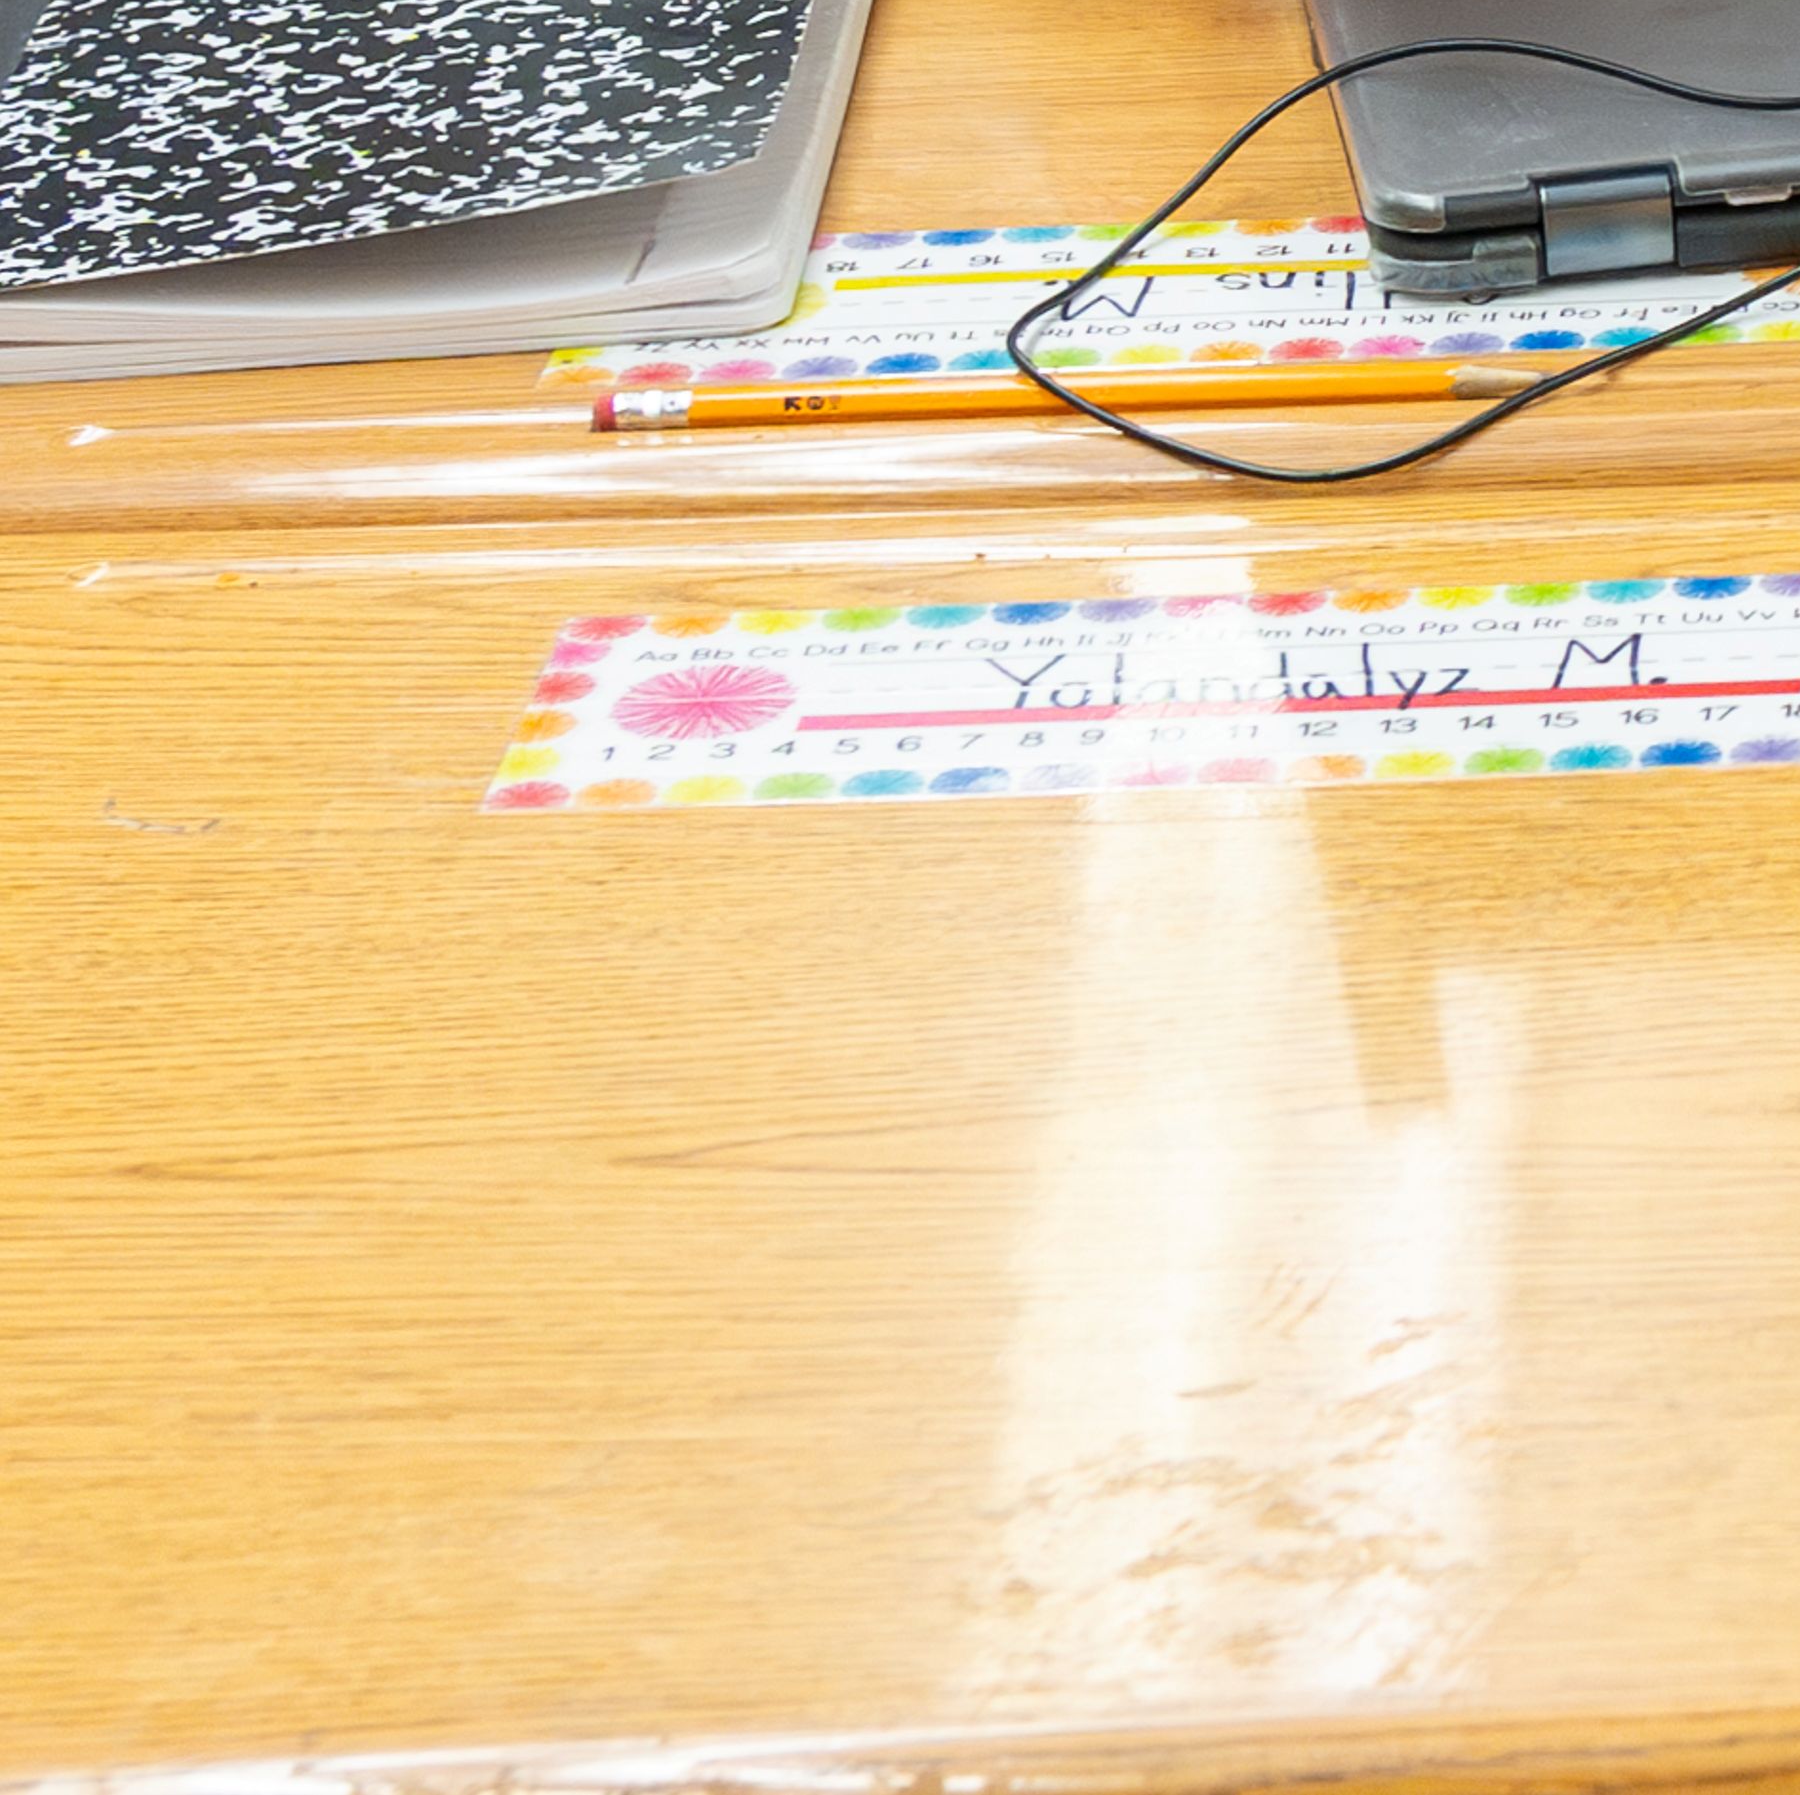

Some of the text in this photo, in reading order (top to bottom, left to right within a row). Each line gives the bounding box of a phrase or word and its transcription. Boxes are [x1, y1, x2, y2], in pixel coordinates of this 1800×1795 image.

[636, 642, 847, 663] Aa Bb Cc Dd
[1551, 633, 1669, 690] M.
[602, 746, 614, 762] 1
[647, 744, 674, 762] 2
[708, 742, 736, 759] 3
[770, 740, 798, 757] 4
[832, 738, 861, 755] 5
[897, 735, 923, 752] 6
[961, 733, 986, 750] 7
[1019, 731, 1044, 748] 8
[1079, 728, 1106, 746] 9
[1299, 719, 1337, 737] 12
[1380, 718, 1418, 735] 13
[1459, 714, 1497, 732] 14
[1540, 711, 1580, 729] 15
[1622, 708, 1660, 726] 16
[1702, 705, 1738, 722] 17
